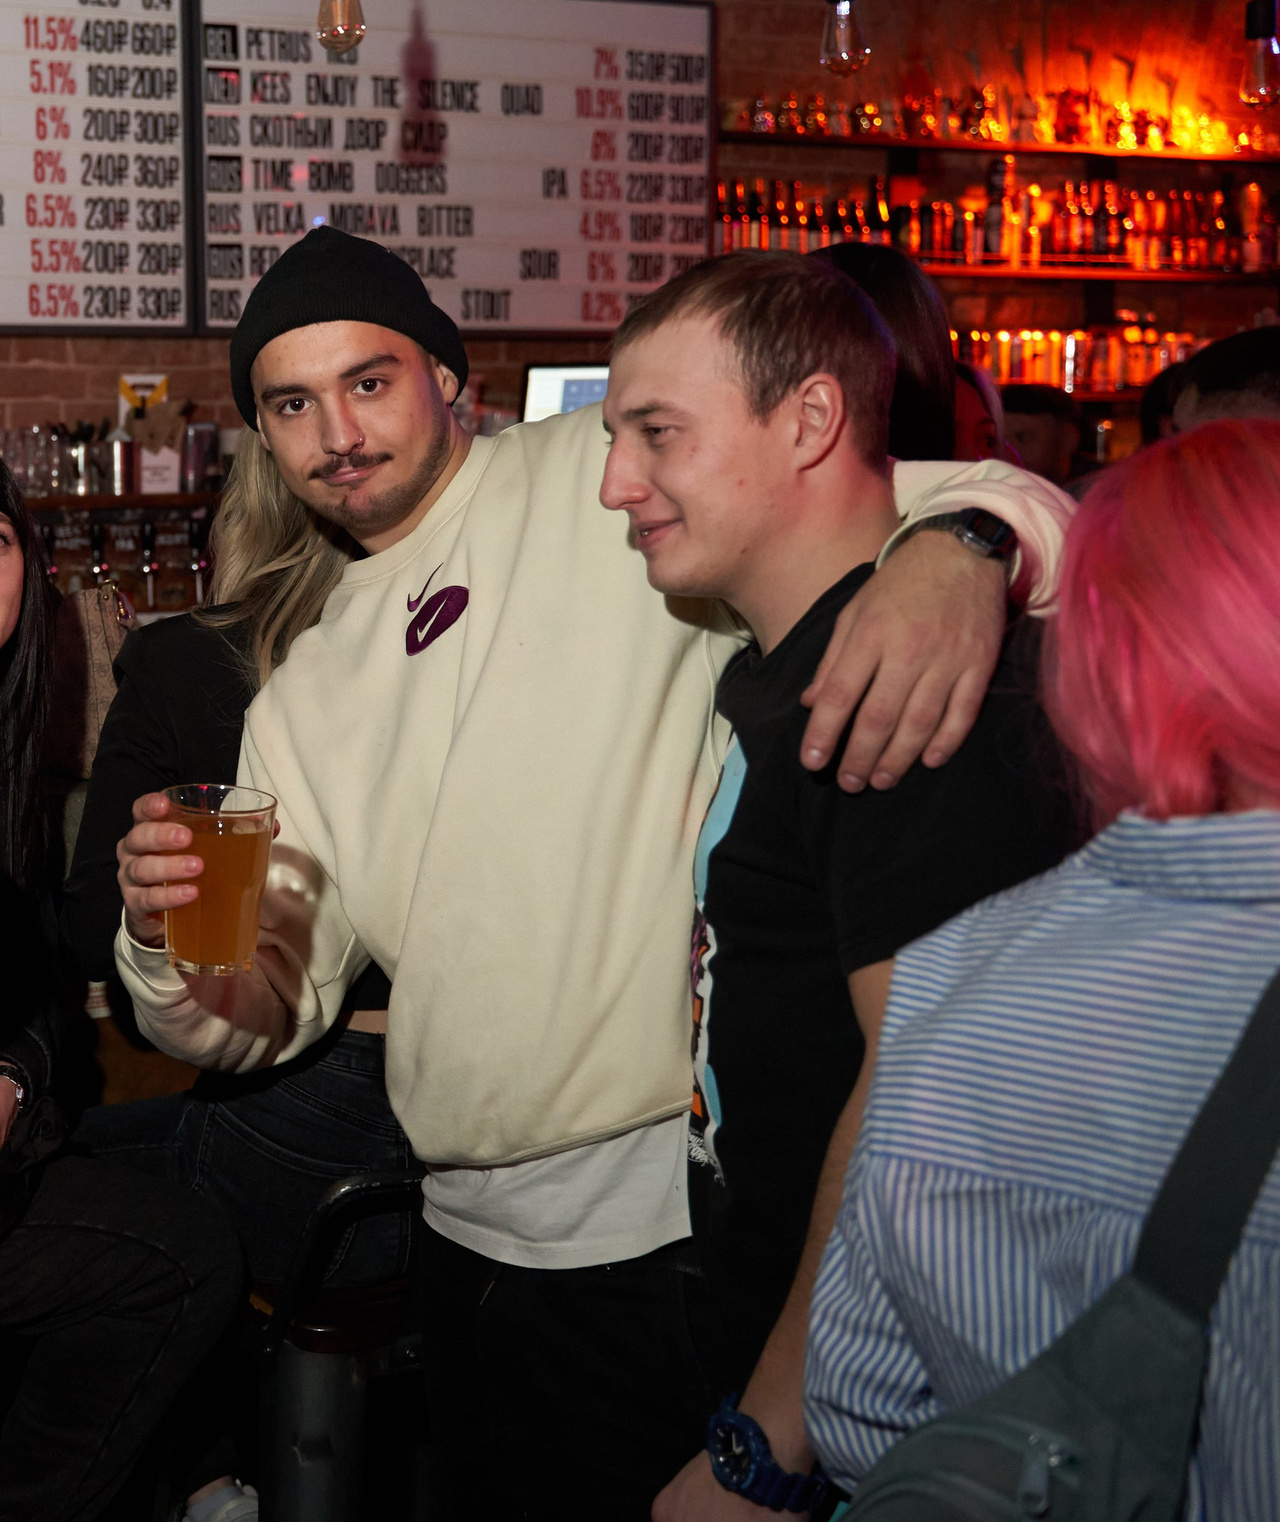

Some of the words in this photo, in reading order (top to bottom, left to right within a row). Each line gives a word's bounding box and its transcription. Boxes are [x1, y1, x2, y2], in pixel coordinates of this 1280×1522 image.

[23, 15, 78, 52] 11.5%
[79, 20, 128, 54] 460₽
[246, 28, 313, 64] PETRUS
[29, 59, 76, 95] 5.1%
[306, 73, 358, 108] ENJOY
[371, 76, 400, 109] THE
[501, 83, 543, 117] QUAD
[35, 106, 70, 141] 6%
[83, 108, 130, 142] 200₽
[207, 115, 240, 147] RUS
[33, 149, 66, 184] 8%
[81, 154, 128, 186] 240₽
[252, 158, 294, 192] TIME
[308, 160, 354, 193] BOMB
[542, 167, 568, 199] IPA
[25, 193, 77, 228] 6.5%
[85, 197, 129, 231] 230₽
[209, 204, 241, 234] RUS
[253, 203, 305, 235] VELKA
[417, 205, 474, 237] BITTER
[30, 238, 81, 273] 5.5%
[82, 239, 129, 273] 200₽
[28, 283, 78, 318] 6.5%
[83, 285, 131, 318] 230₽
[210, 289, 241, 320] RUS
[461, 289, 512, 320] STOUT
